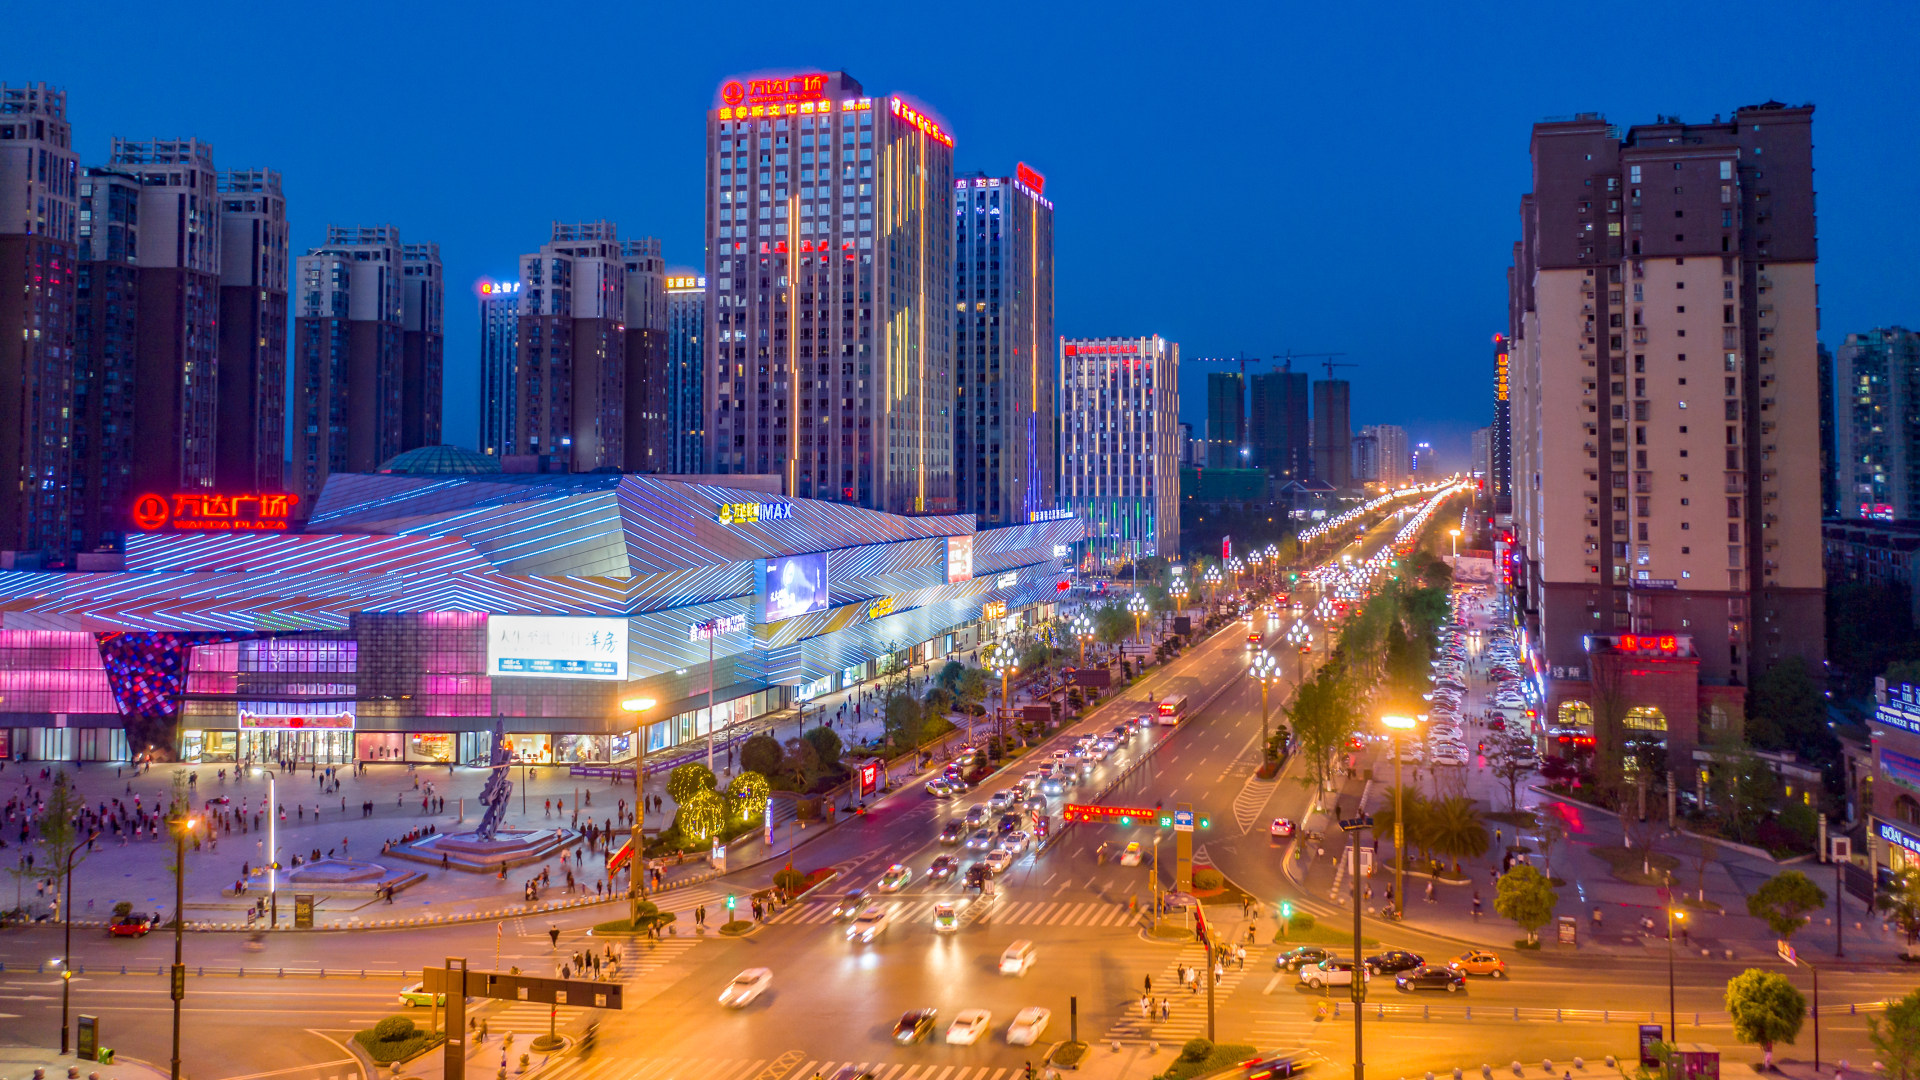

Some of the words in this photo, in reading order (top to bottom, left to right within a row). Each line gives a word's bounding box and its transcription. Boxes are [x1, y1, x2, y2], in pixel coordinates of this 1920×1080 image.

[748, 76, 823, 95] 万达广场
[1077, 345, 1107, 354] WANDA
[1108, 344, 1138, 354] REALM
[172, 493, 288, 517] 万达广场
[760, 503, 793, 520] IMAX
[174, 520, 231, 530] WANDA
[234, 520, 288, 530] PLAZA
[1552, 666, 1580, 679] 诊所
[1161, 817, 1171, 826] 32
